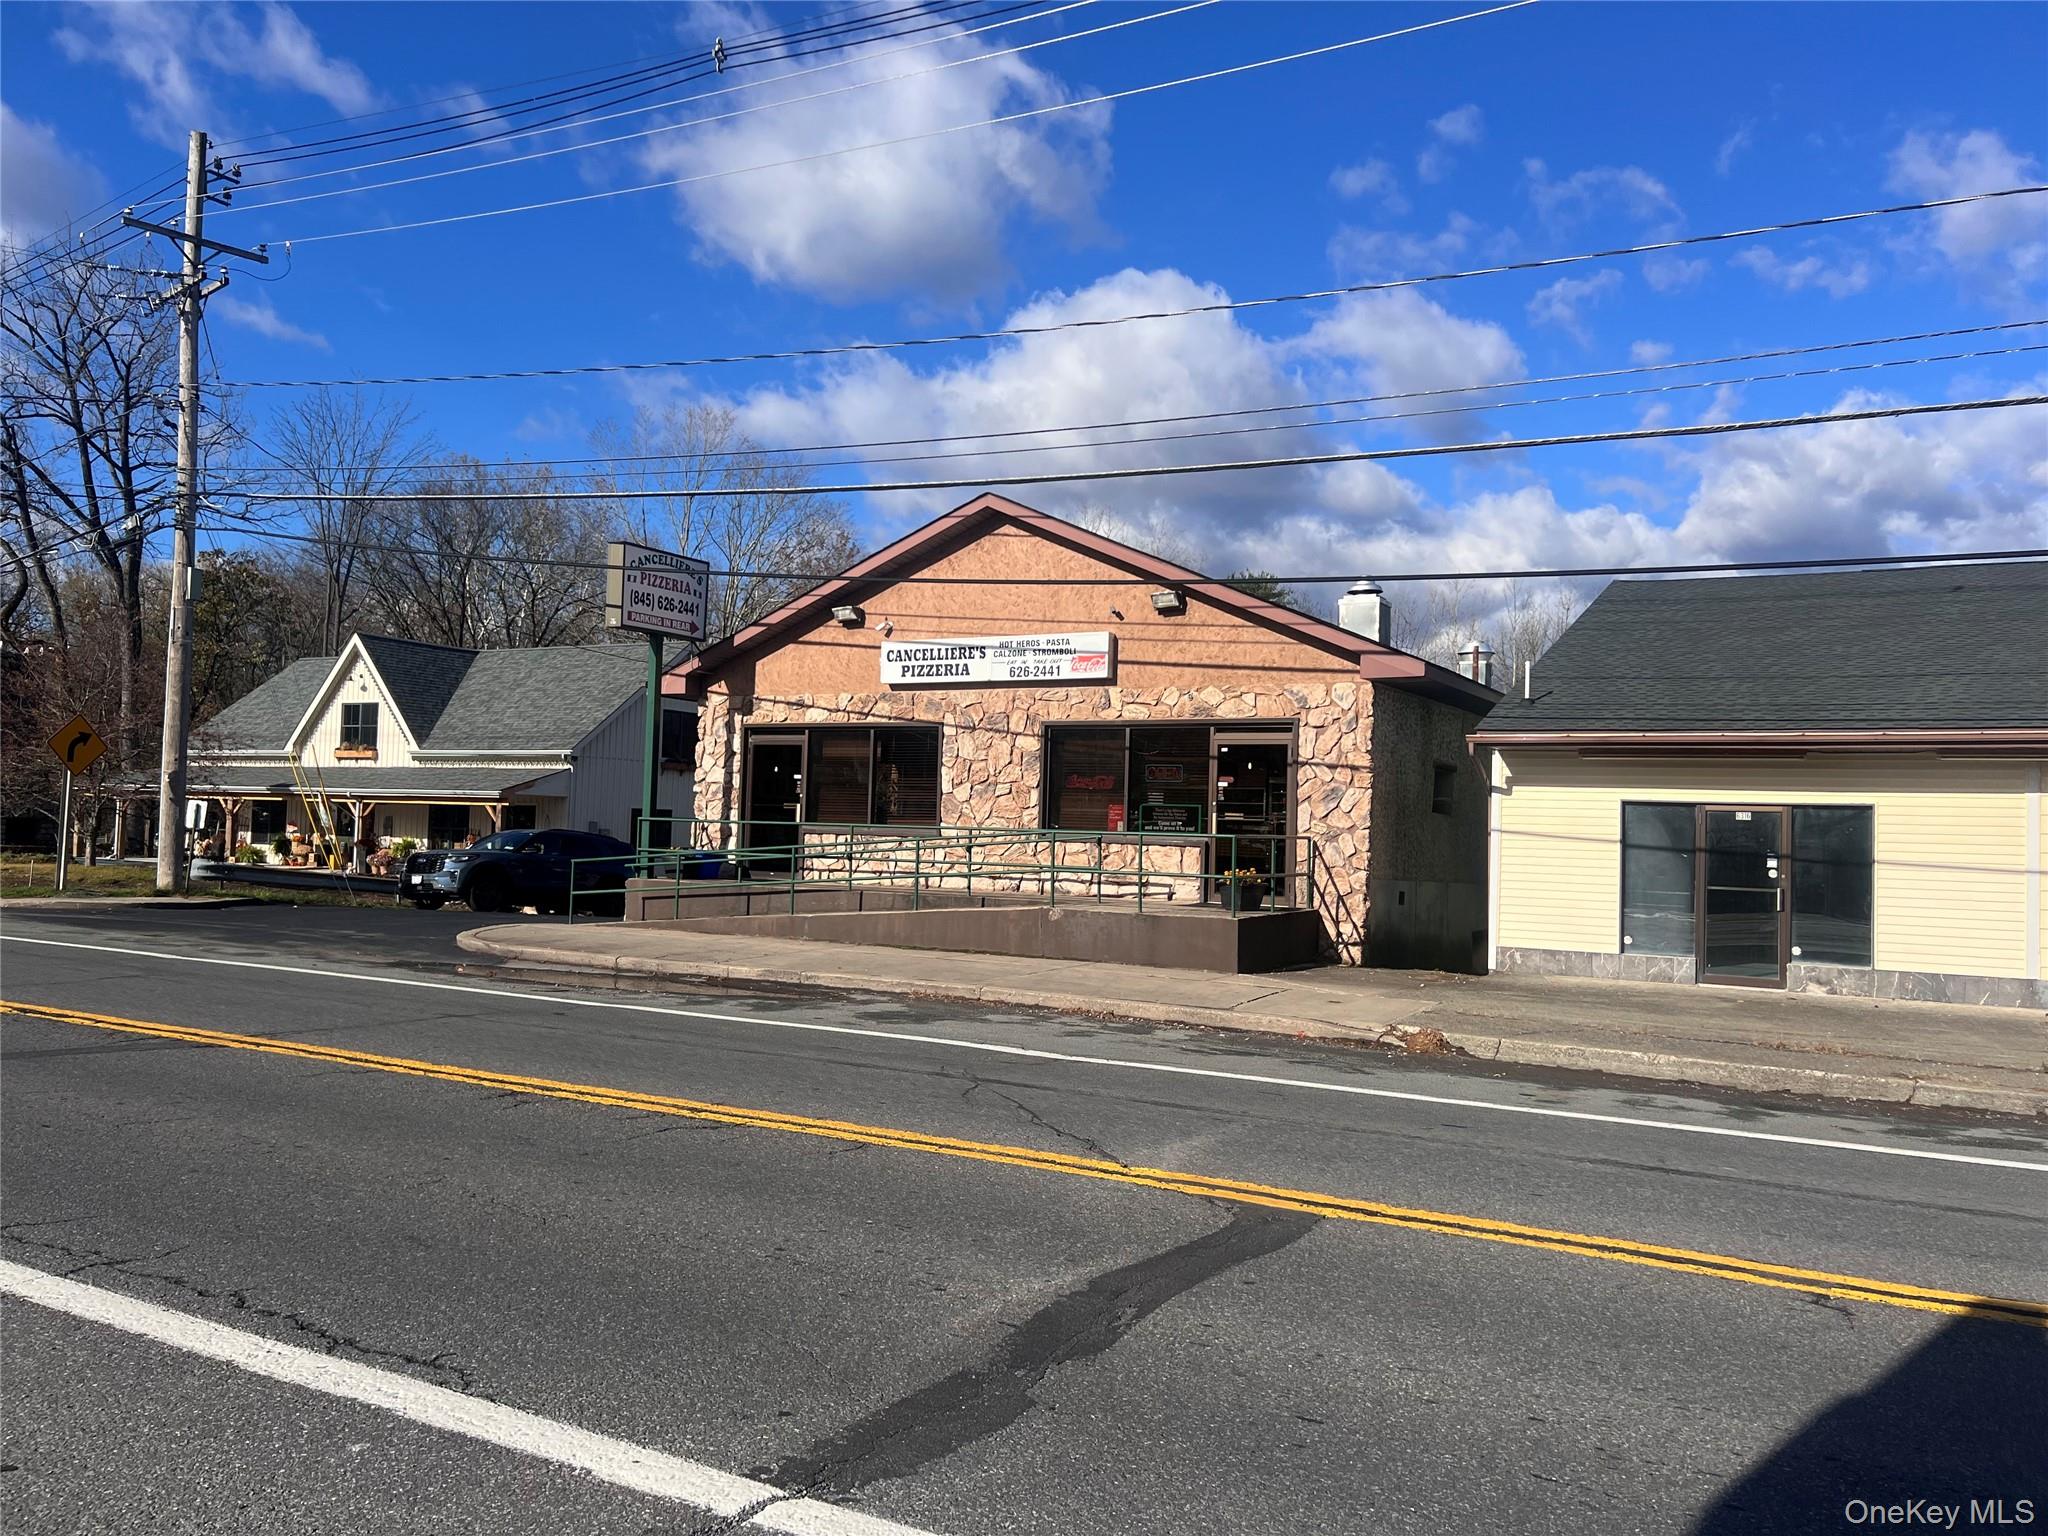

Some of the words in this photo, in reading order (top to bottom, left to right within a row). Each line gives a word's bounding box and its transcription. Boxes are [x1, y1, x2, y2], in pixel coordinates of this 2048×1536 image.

[630, 554, 704, 586] CANCELLIERES
[640, 572, 691, 595] PIZZERIA
[630, 589, 654, 611] (845)
[657, 595, 700, 617] 626-2441
[631, 612, 663, 626] PARKING
[663, 618, 671, 628] IN
[672, 620, 690, 632] REAR
[999, 640, 1013, 649] HOT
[1016, 639, 1041, 648] HEROS
[1046, 638, 1070, 646] PASTA
[886, 646, 986, 662] CANCELLIERE'S
[993, 649, 1027, 658] CALZONE
[1032, 647, 1077, 656] STROMBOLI
[901, 663, 970, 678] PIZZERIA
[1009, 665, 1061, 678] 626-2441
